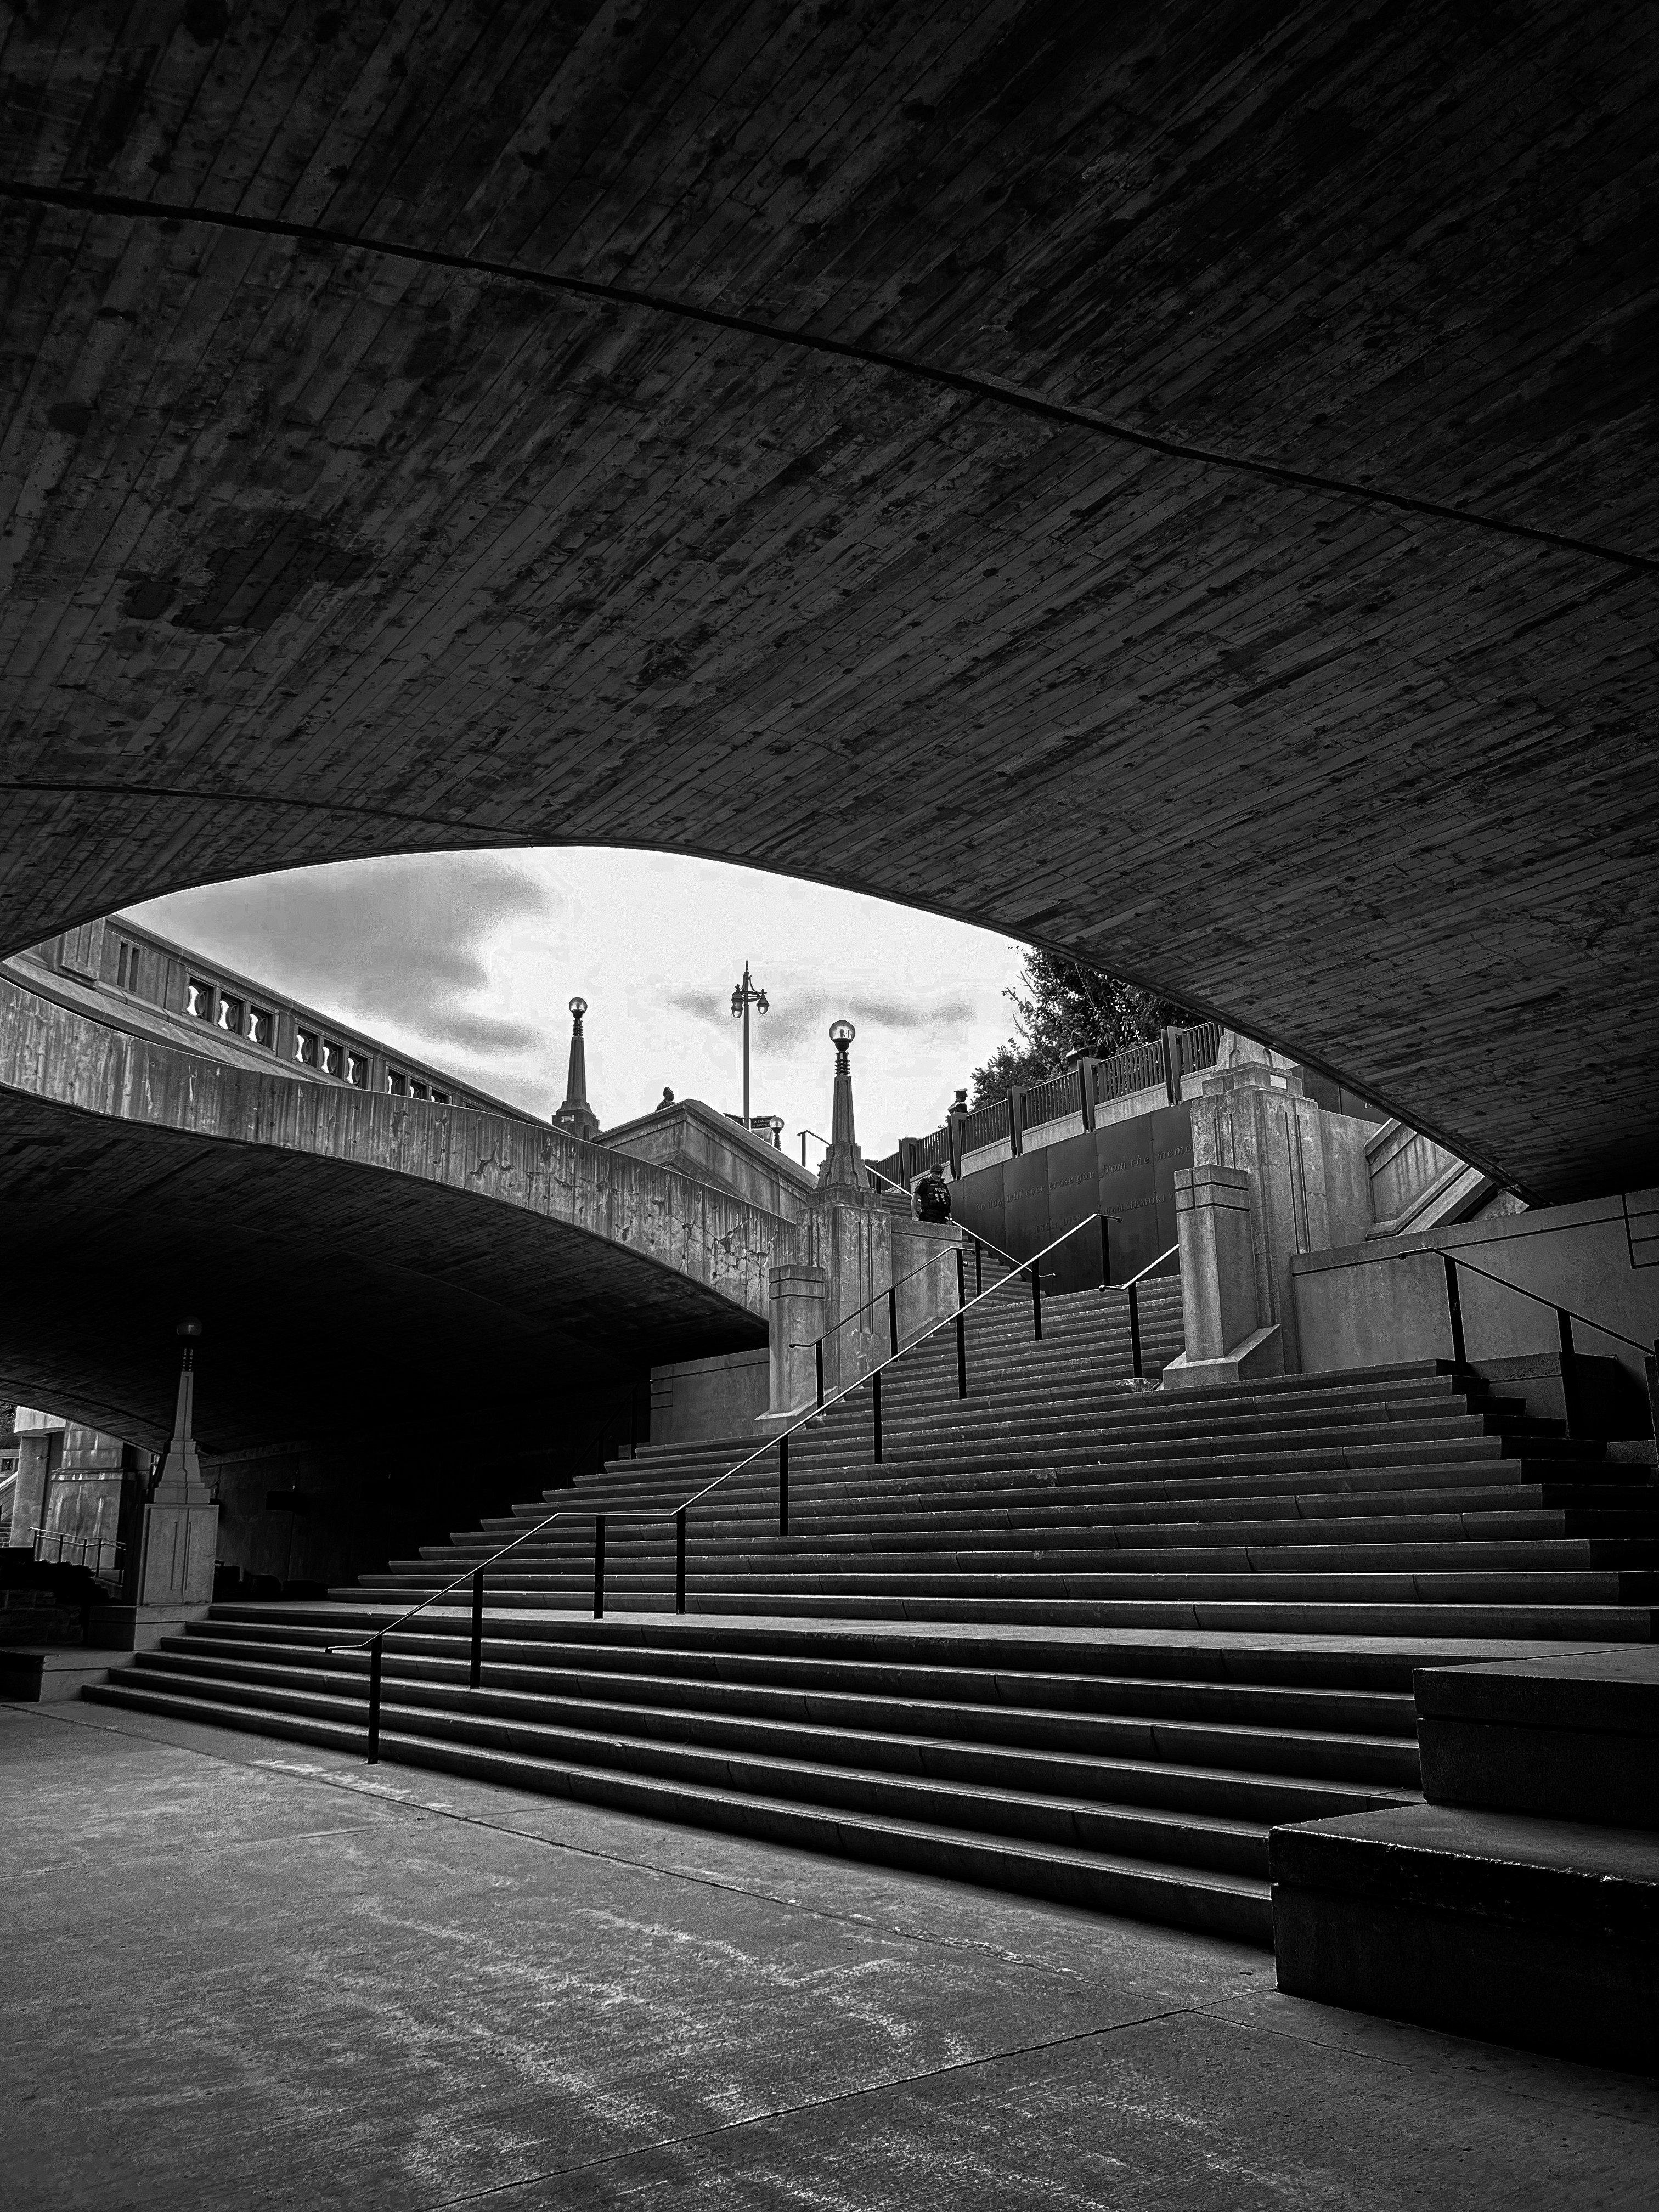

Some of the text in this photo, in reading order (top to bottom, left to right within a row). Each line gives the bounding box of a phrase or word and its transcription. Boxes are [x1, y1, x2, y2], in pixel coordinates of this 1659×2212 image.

[975, 1203, 985, 1212] No
[988, 1198, 1003, 1209] day
[1006, 1189, 1023, 1203] will
[1025, 1184, 1045, 1197] ever
[1049, 1177, 1074, 1190] erase
[1076, 1171, 1096, 1185] you
[1101, 1161, 1127, 1178] from
[1130, 1155, 1150, 1168] the
